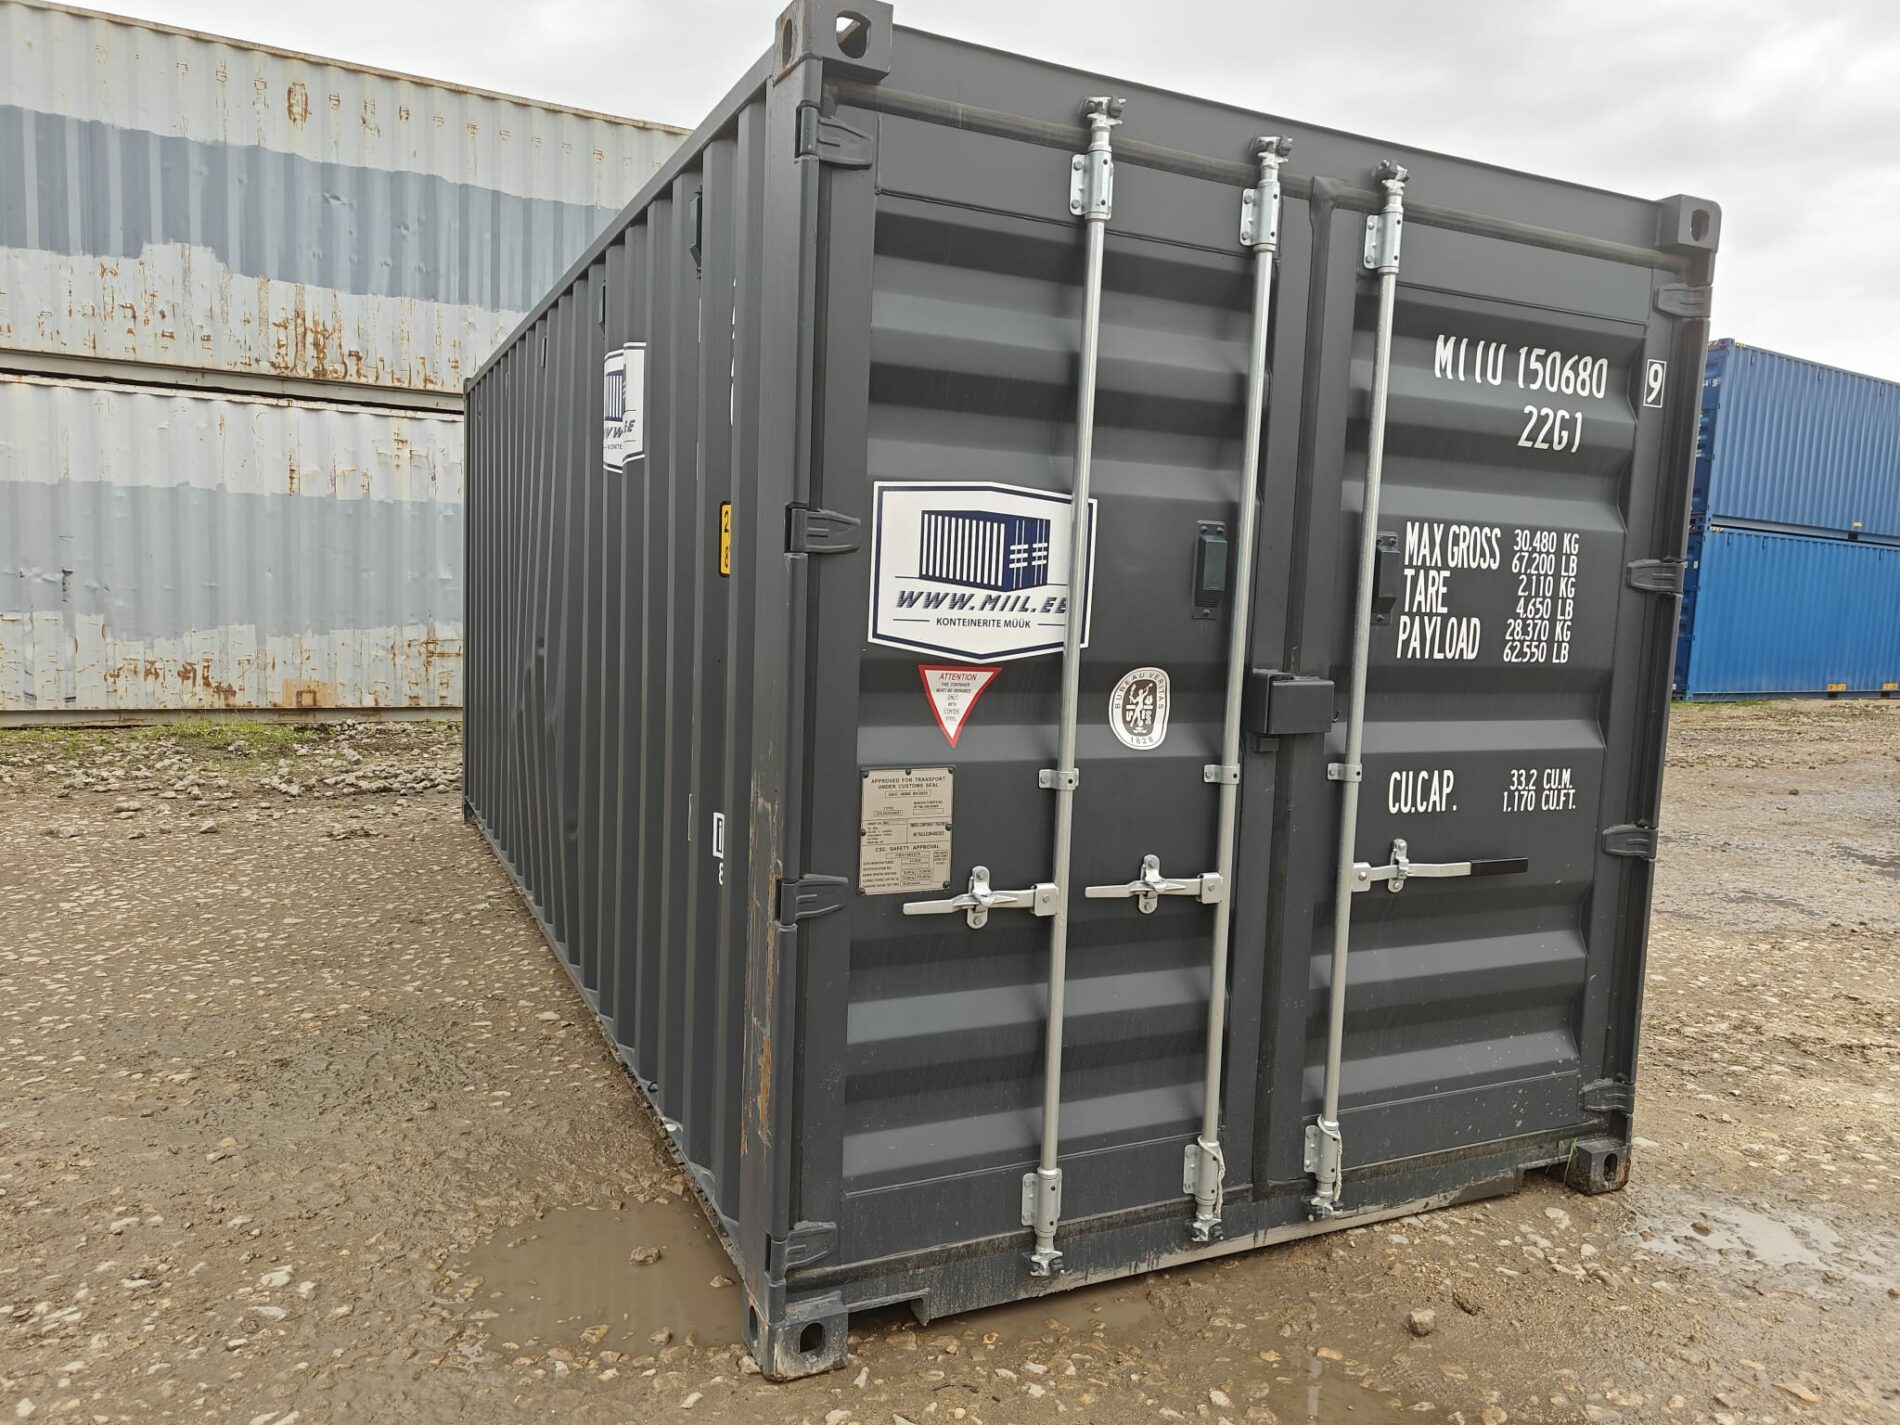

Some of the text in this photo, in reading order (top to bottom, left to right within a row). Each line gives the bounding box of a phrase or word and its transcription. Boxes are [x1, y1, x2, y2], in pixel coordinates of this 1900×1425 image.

[1434, 335, 1663, 404] MIIU 150680 9
[1517, 405, 1583, 453] 22G1
[1404, 521, 1579, 570] MAX GROSS 30,480 KG
[1512, 552, 1578, 576] 67,200 LB
[1404, 569, 1576, 614] TARE 2,110 KG
[1516, 597, 1574, 620] 4,650 LB
[936, 617, 1031, 630] KONTEINERITE MÜÜK
[1396, 615, 1572, 660] PAYLOAD 28,370 KG
[1503, 641, 1569, 664] 62,550 LB
[939, 672, 977, 681] ATTENTION
[1115, 672, 1165, 709] BUREAU VERITAS
[1388, 768, 1573, 814] CU.CAP. 33.2 CU.M.
[1541, 789, 1576, 811] CU.FT.
